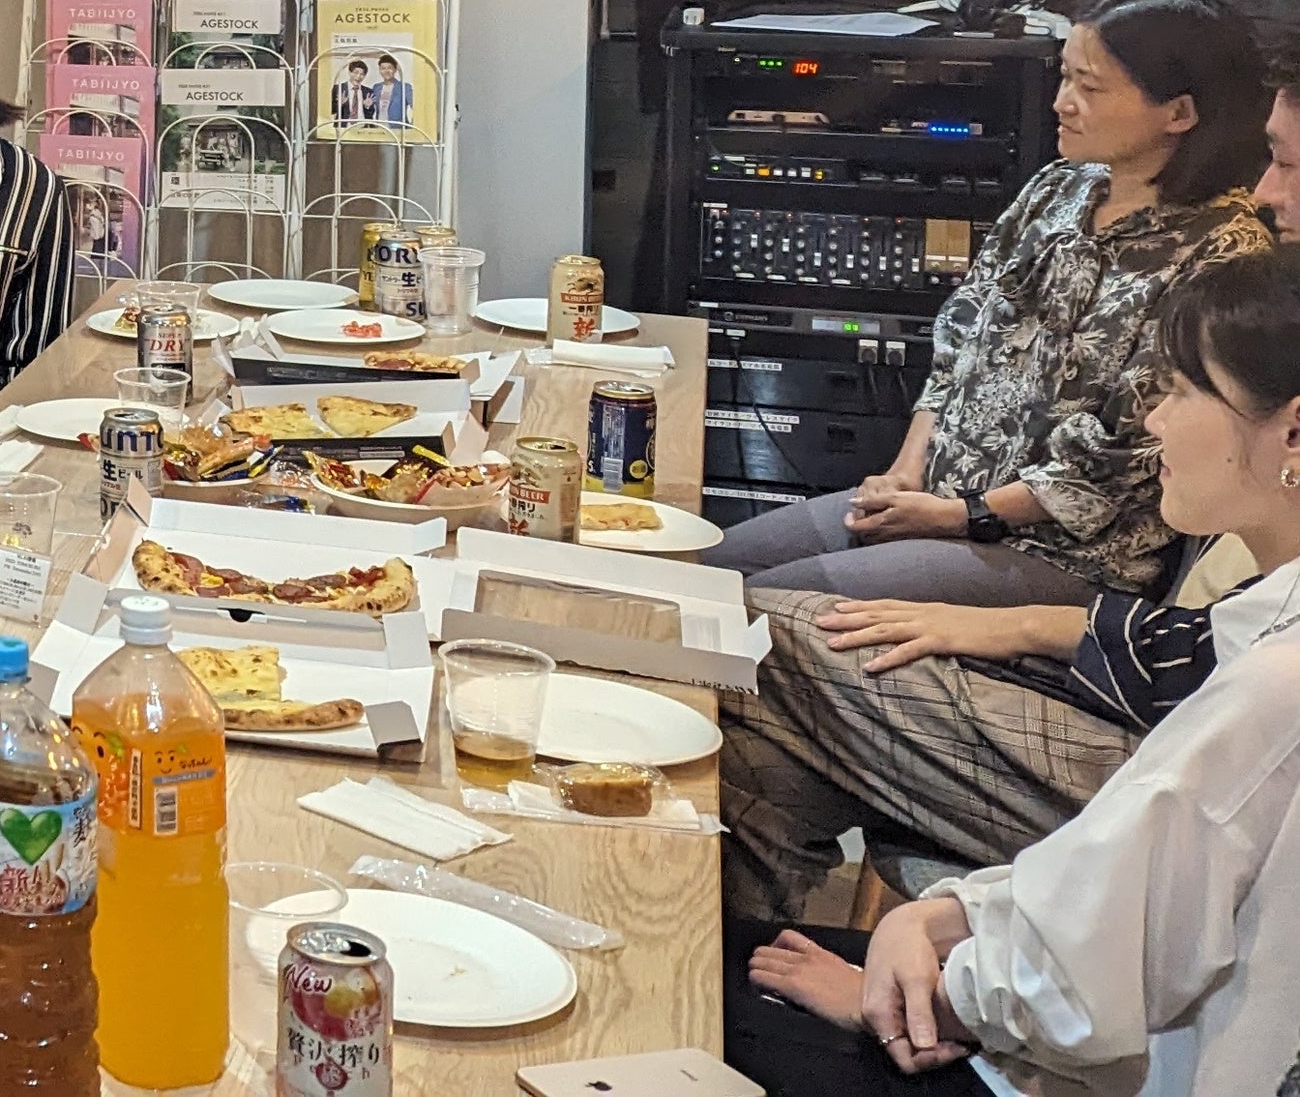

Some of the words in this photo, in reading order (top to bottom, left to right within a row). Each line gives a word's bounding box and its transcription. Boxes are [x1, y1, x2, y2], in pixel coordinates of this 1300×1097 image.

[200, 18, 259, 30] AGESTOCK
[335, 12, 411, 24] AGESTOCK
[795, 62, 818, 74] 104
[186, 90, 244, 102] AGESTOCK
[284, 964, 333, 994] New
